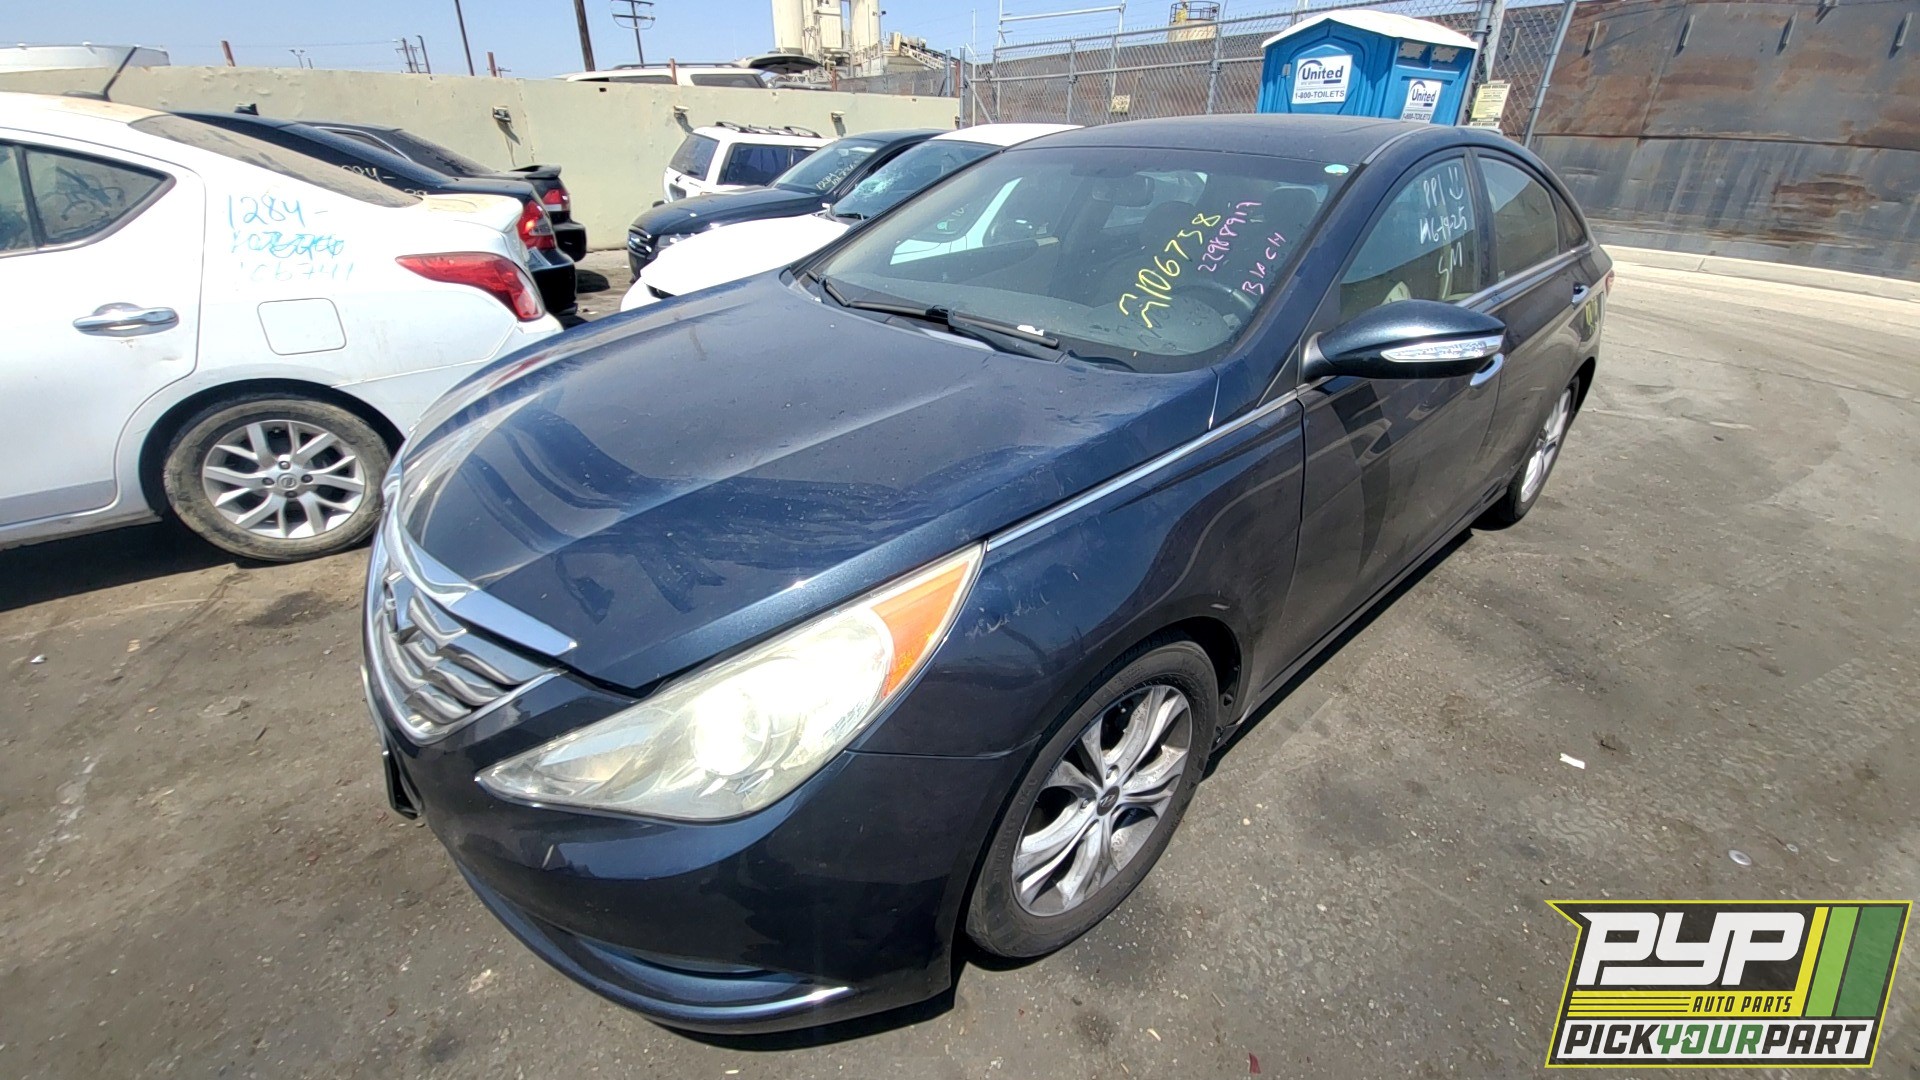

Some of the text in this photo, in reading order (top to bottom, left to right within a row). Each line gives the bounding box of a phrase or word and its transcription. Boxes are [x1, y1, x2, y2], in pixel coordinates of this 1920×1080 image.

[1302, 65, 1344, 80] United
[1295, 90, 1345, 99] 1-800-TOILETS
[1411, 88, 1437, 102] United
